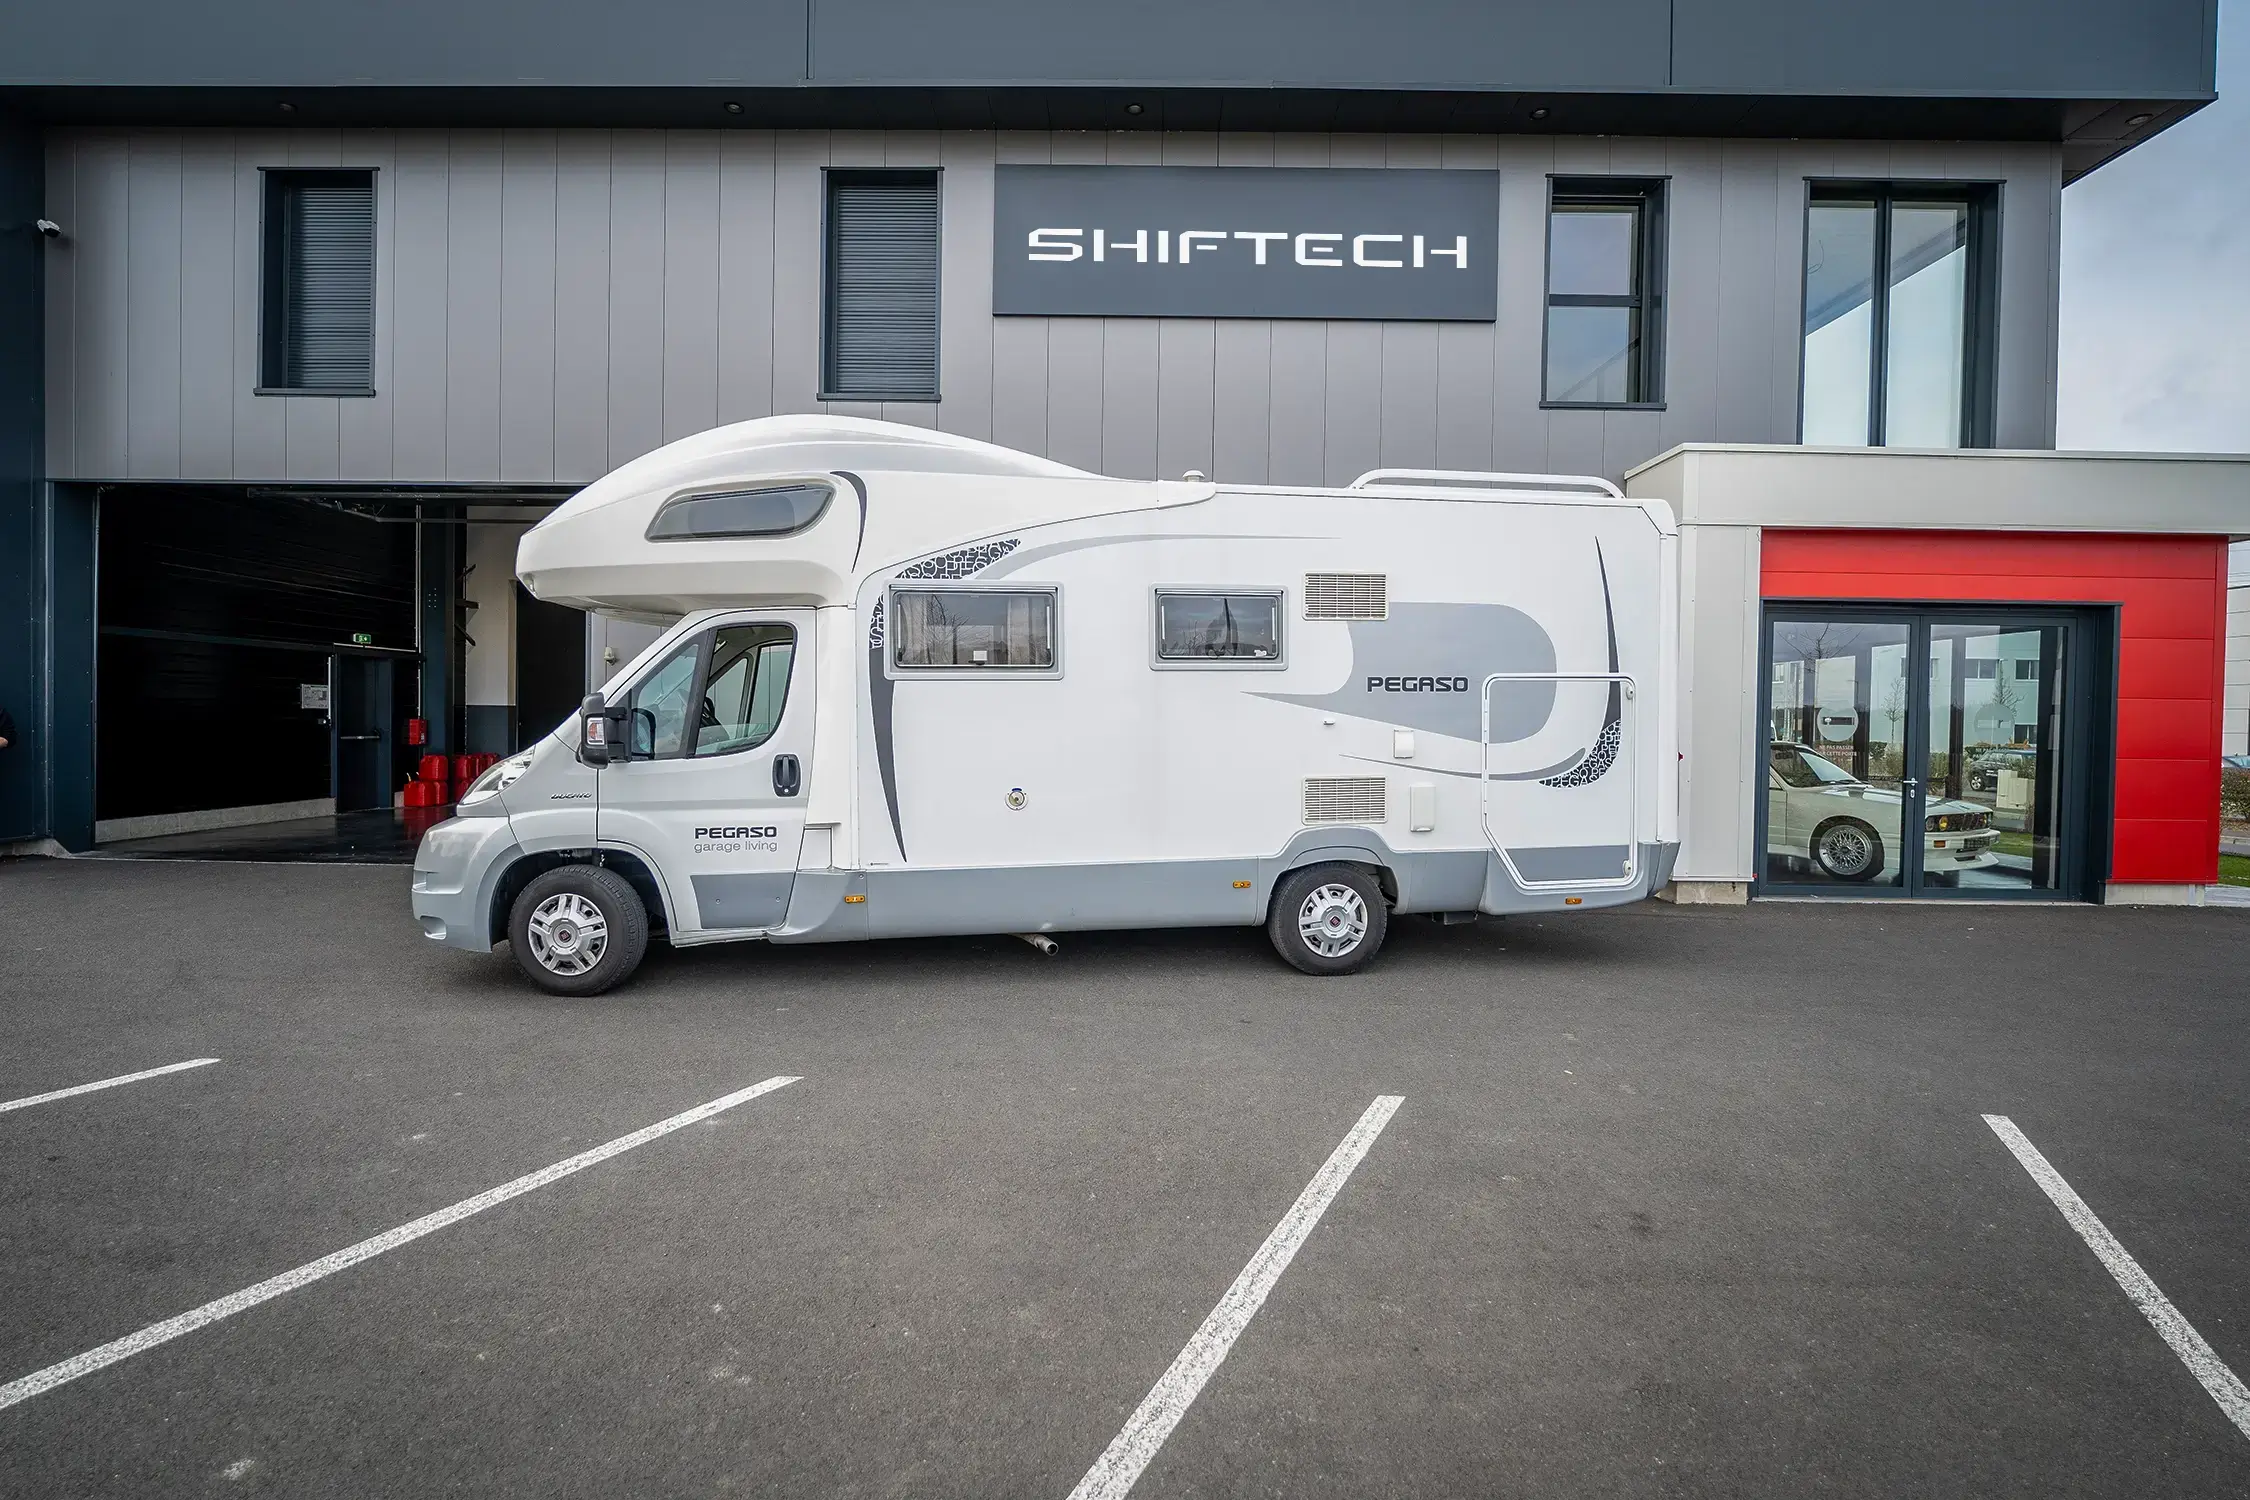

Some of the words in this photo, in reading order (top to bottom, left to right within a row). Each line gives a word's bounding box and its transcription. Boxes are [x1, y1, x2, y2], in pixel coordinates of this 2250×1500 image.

[1028, 227, 1467, 269] SHIFTECH
[1366, 676, 1469, 693] PEGASO
[694, 826, 778, 839] PEGASO
[693, 842, 741, 854] garage
[744, 840, 778, 852] living
